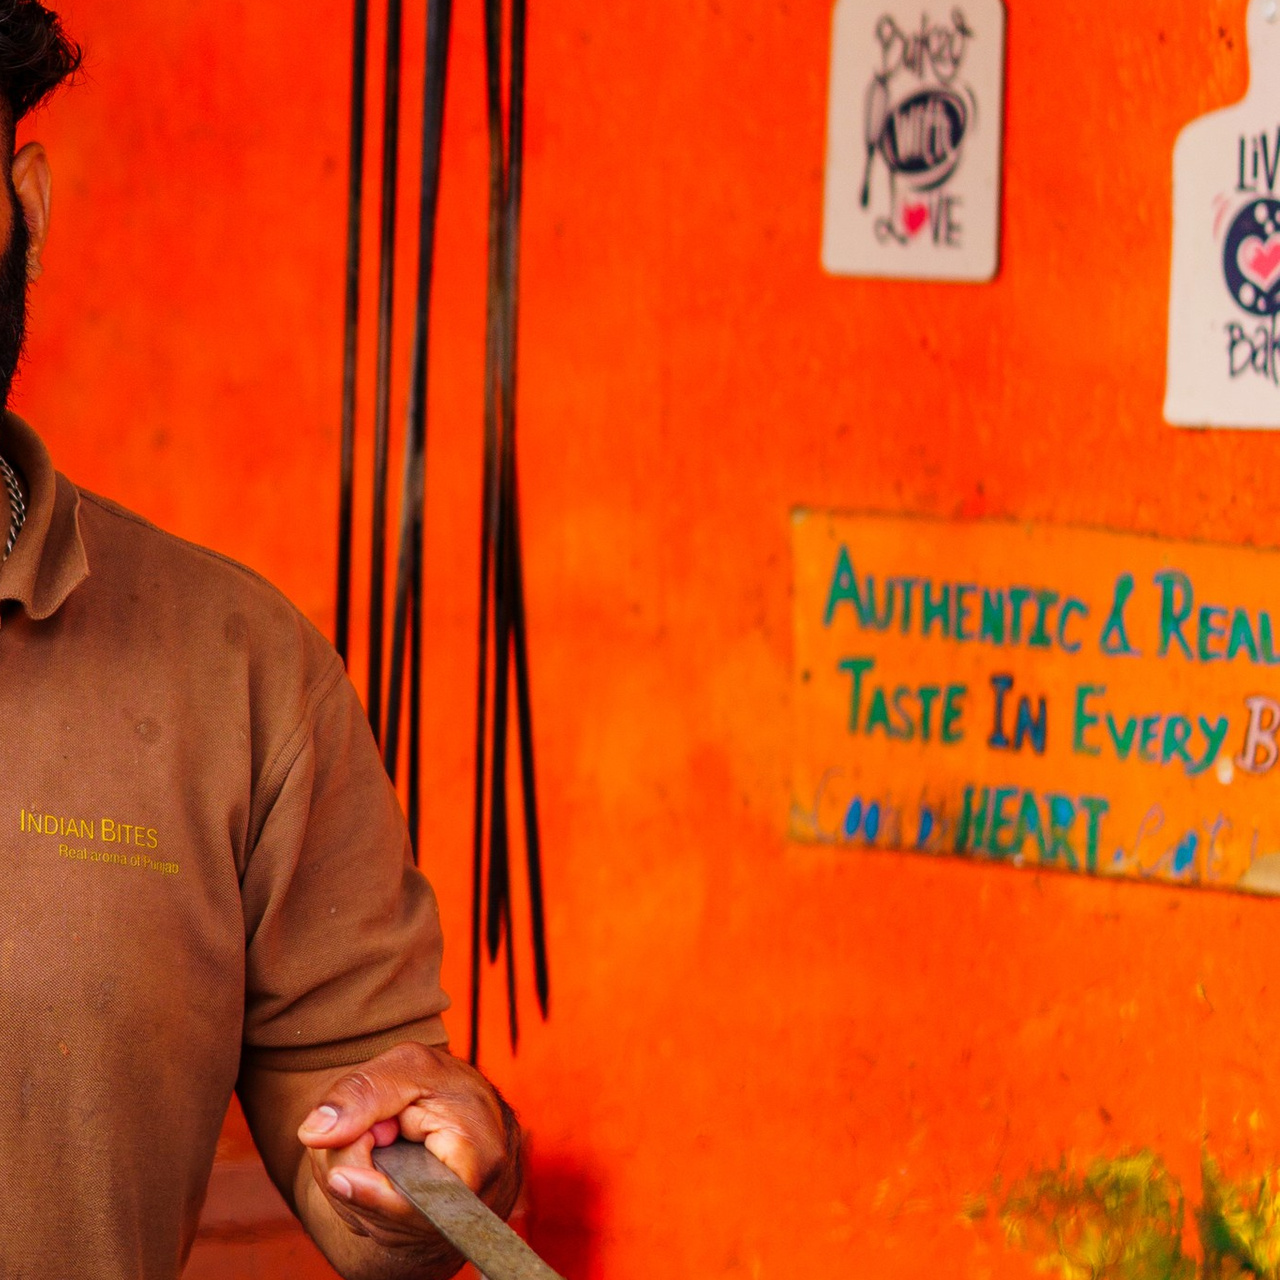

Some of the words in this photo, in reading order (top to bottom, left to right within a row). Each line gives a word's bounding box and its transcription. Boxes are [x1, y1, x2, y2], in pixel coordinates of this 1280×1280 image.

[1099, 571, 1141, 657] &
[838, 657, 968, 745] TASTE
[987, 673, 1047, 755] IN
[58, 843, 87, 861] Real
[90, 851, 127, 866] aroma
[130, 854, 141, 867] of
[143, 855, 180, 875] Punjab
